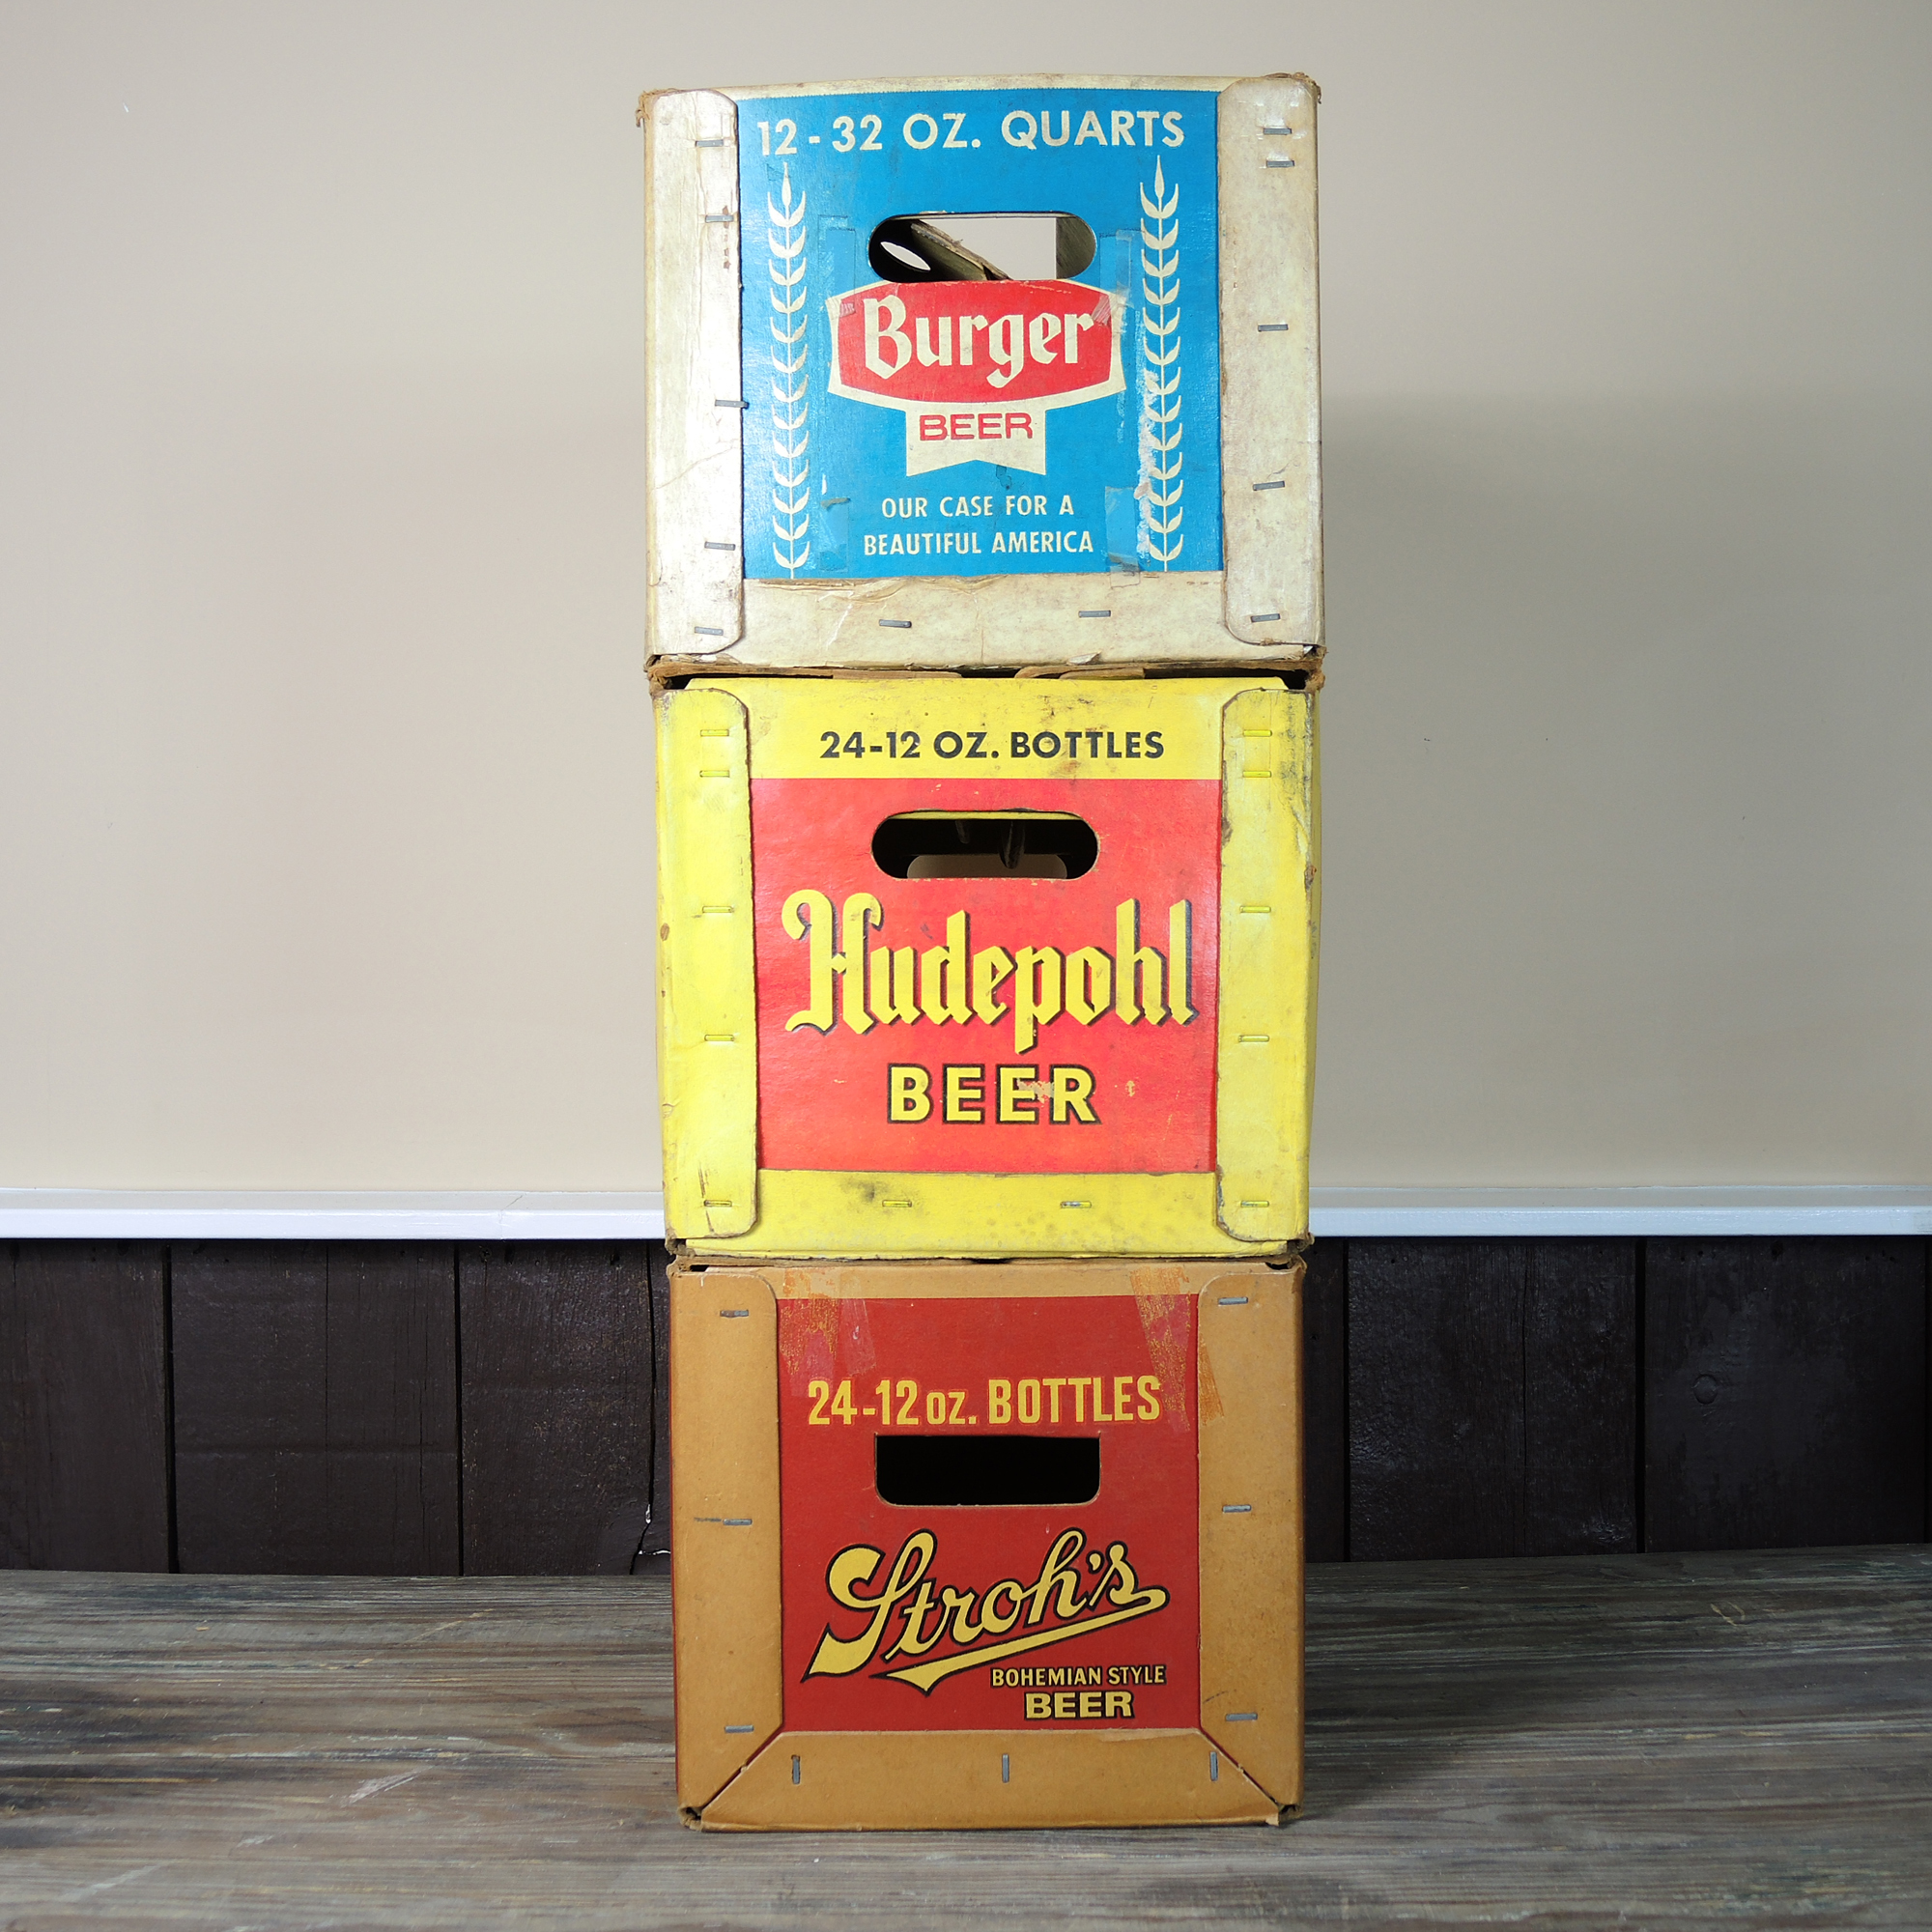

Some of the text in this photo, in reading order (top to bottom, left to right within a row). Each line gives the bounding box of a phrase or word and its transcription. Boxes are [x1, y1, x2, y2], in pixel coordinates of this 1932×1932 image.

[903, 112, 981, 150] OZ.
[1002, 109, 1185, 150] QUARTS
[864, 295, 1095, 389] Burger
[919, 412, 1034, 441] BEER
[882, 496, 1075, 519] OUR CASE FOR A
[864, 531, 1094, 555] BEAUTIFUL AMERICA
[819, 730, 1165, 760] 24-12 OZ. BOTTLES
[781, 889, 1200, 1055] Hudepohl
[887, 1063, 1101, 1125] BEER
[808, 1378, 920, 1426] 24-12
[987, 1375, 1161, 1425] BOTTLES
[801, 1527, 1170, 1696] Stroh's
[990, 1663, 1167, 1689] BOHEMIAN STYLE
[1024, 1690, 1136, 1720] BEER
